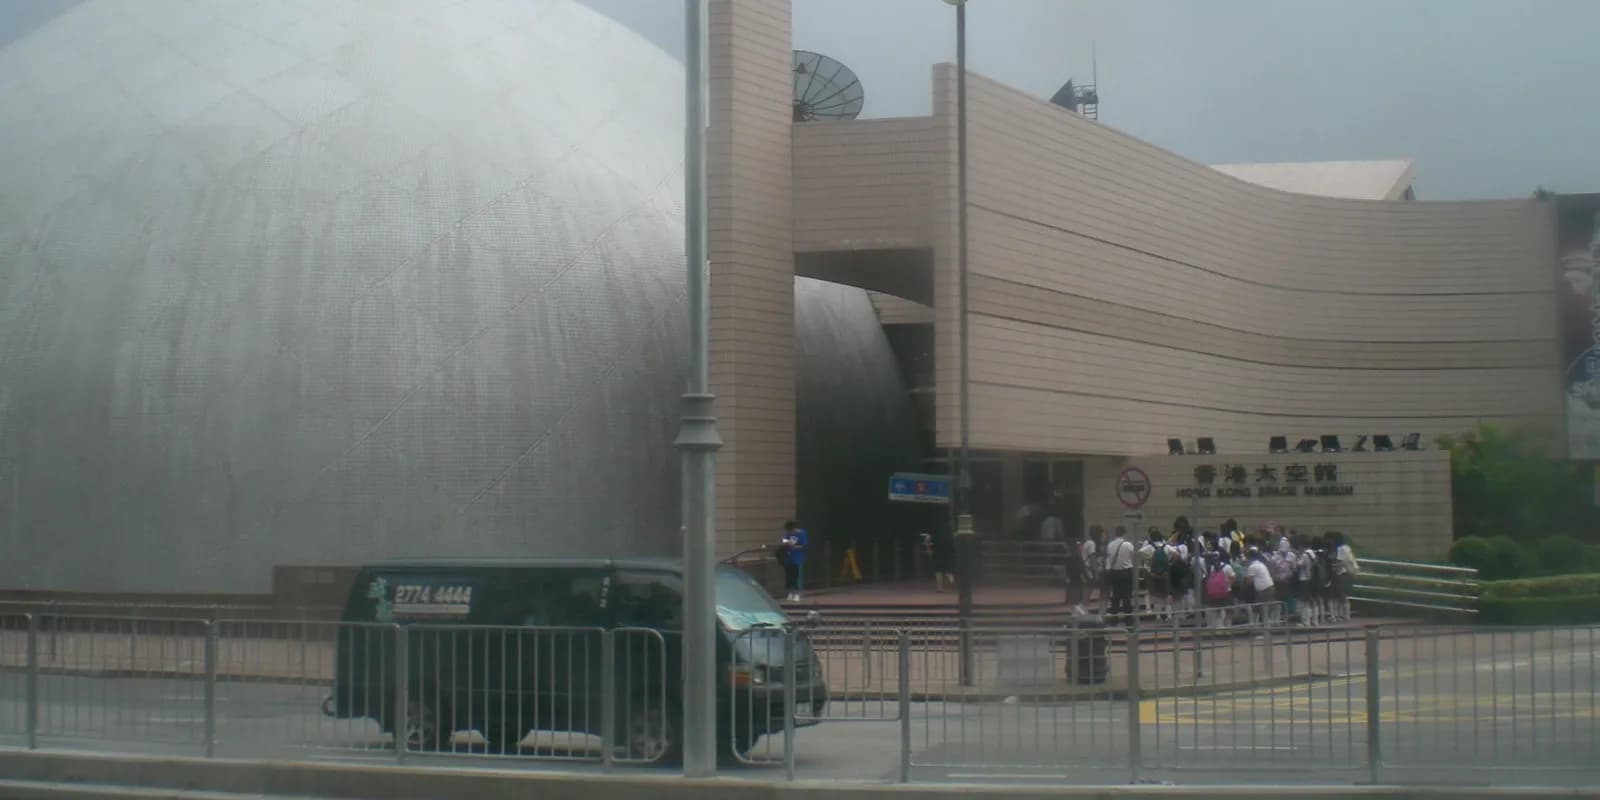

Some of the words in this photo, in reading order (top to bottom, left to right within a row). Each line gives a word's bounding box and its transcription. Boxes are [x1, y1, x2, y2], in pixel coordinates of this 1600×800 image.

[1193, 464, 1338, 484] 香港太空館
[1176, 487, 1210, 497] HONG
[1217, 487, 1251, 497] KONG
[1258, 486, 1297, 497] SPACE
[1304, 486, 1354, 497] MUSEUM
[395, 585, 430, 602] 2774
[434, 586, 472, 603] 4444
